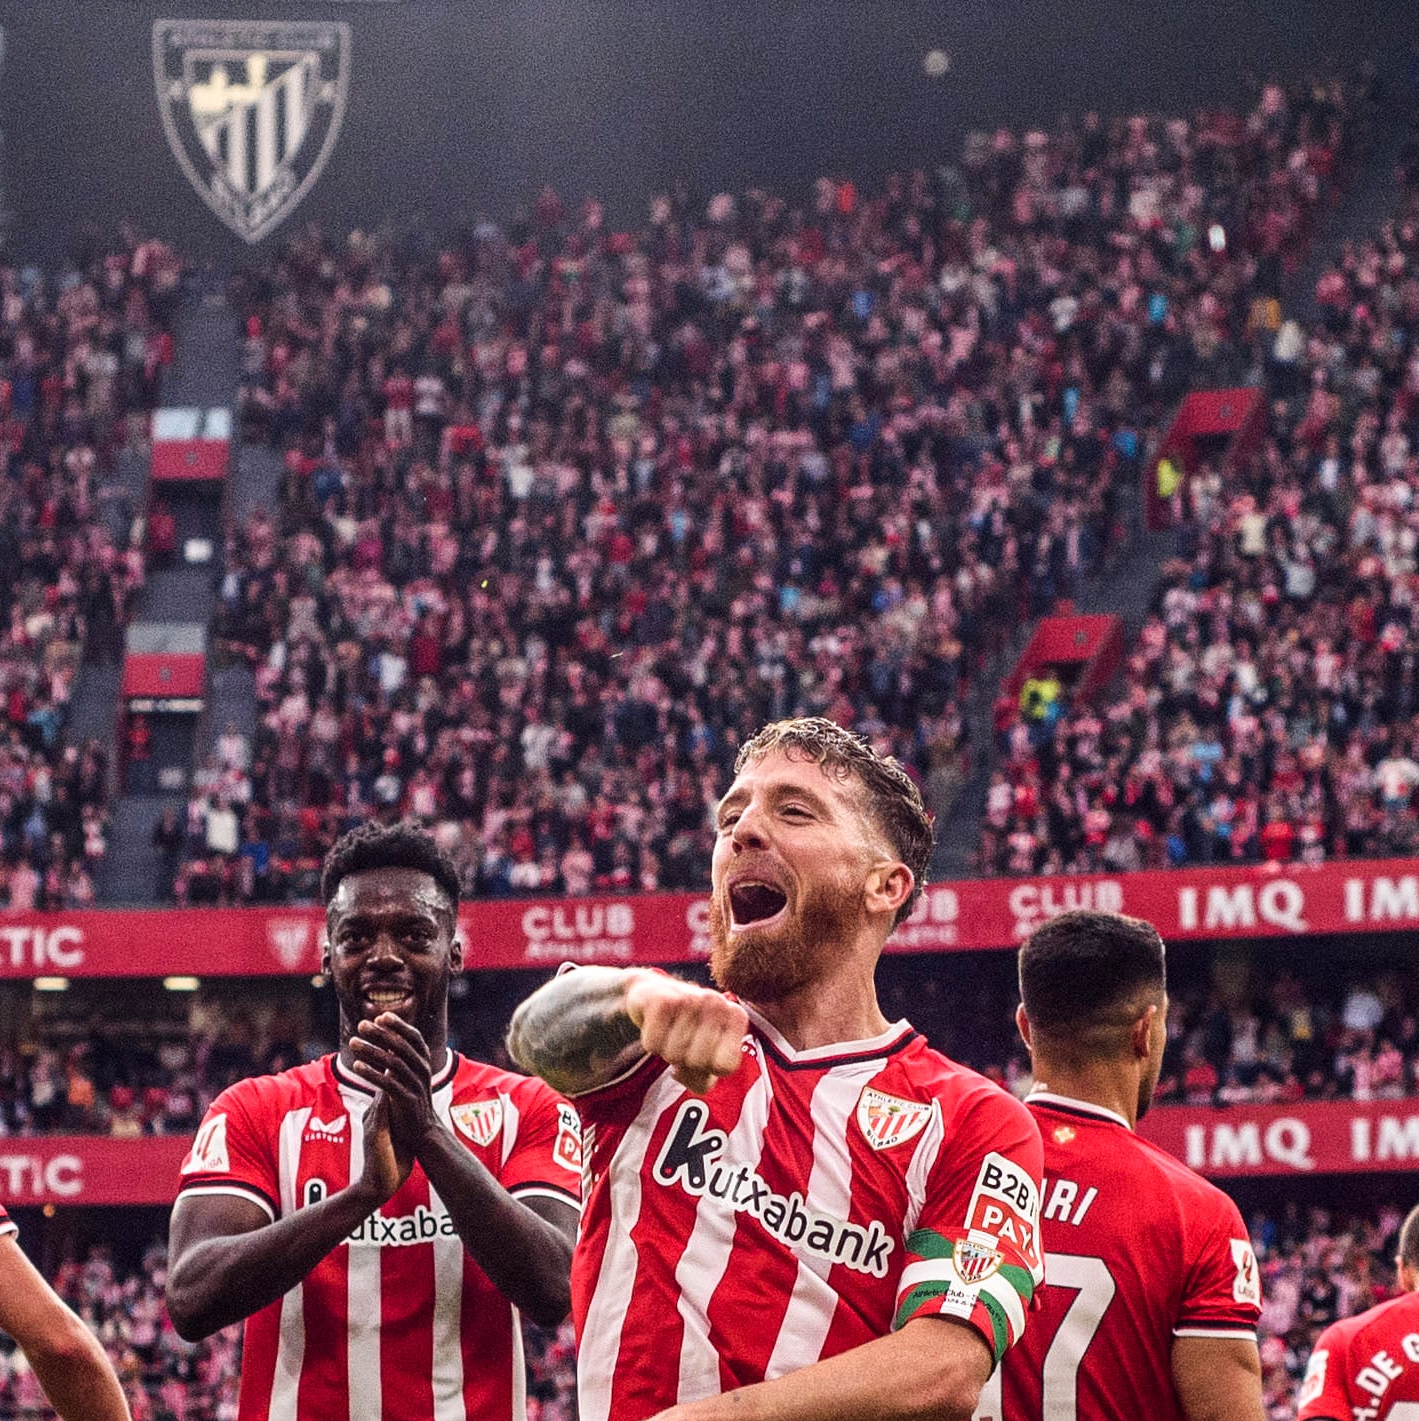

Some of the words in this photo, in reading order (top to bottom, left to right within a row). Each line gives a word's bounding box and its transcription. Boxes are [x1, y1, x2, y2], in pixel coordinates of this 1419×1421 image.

[522, 903, 632, 939] CLUB
[1179, 879, 1308, 932] IMQ
[1185, 1117, 1315, 1169] IMQ
